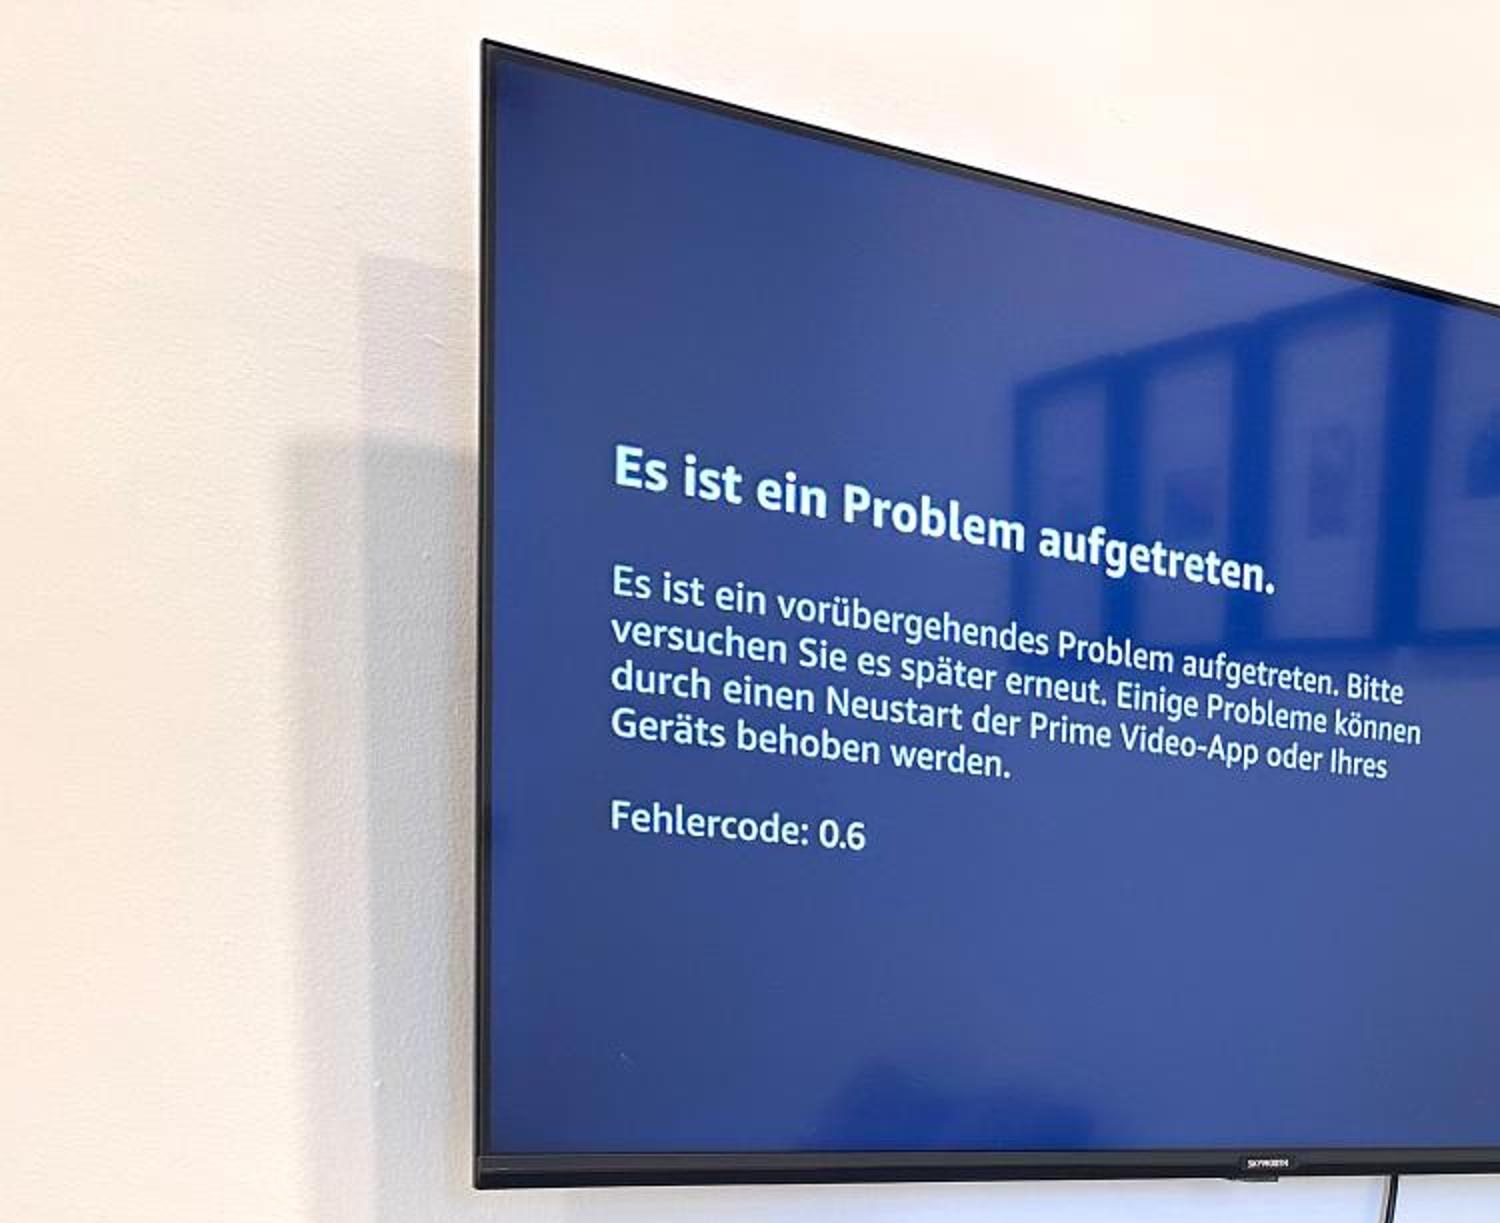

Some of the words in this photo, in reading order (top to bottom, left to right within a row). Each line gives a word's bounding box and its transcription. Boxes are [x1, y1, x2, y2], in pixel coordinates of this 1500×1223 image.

[615, 444, 669, 492] Es
[684, 453, 743, 505] ist
[756, 471, 827, 519] ein
[843, 483, 1025, 553] Problem
[1039, 525, 1276, 596] aufgetreten.
[611, 619, 787, 665] versuchen
[799, 637, 848, 672] Sie
[857, 652, 892, 678] es
[900, 655, 998, 691] später
[1005, 672, 1107, 707] erneut.
[1117, 681, 1199, 723] Einige
[1207, 693, 1328, 733] Probleme
[1334, 708, 1421, 745] können
[613, 564, 652, 599] Es
[663, 571, 705, 607] ist
[715, 581, 766, 616] ein
[777, 595, 1049, 656] vorübergehendes
[1058, 630, 1174, 673] Problem
[1182, 652, 1339, 697] aufgetreten.
[1347, 672, 1404, 705] Bitte
[611, 659, 711, 701] durch
[723, 675, 815, 713] einen
[827, 685, 963, 731] Neustart
[971, 703, 1022, 737] der
[1030, 711, 1112, 748] Prime
[1119, 722, 1259, 771] Video-App
[1266, 741, 1324, 772] oder
[1330, 747, 1388, 779] Ihres
[611, 707, 726, 748] Geräts
[737, 718, 880, 765] behoben
[889, 743, 1011, 779] werden.
[611, 799, 809, 846] Fehlercode:
[819, 819, 866, 851] 0.6
